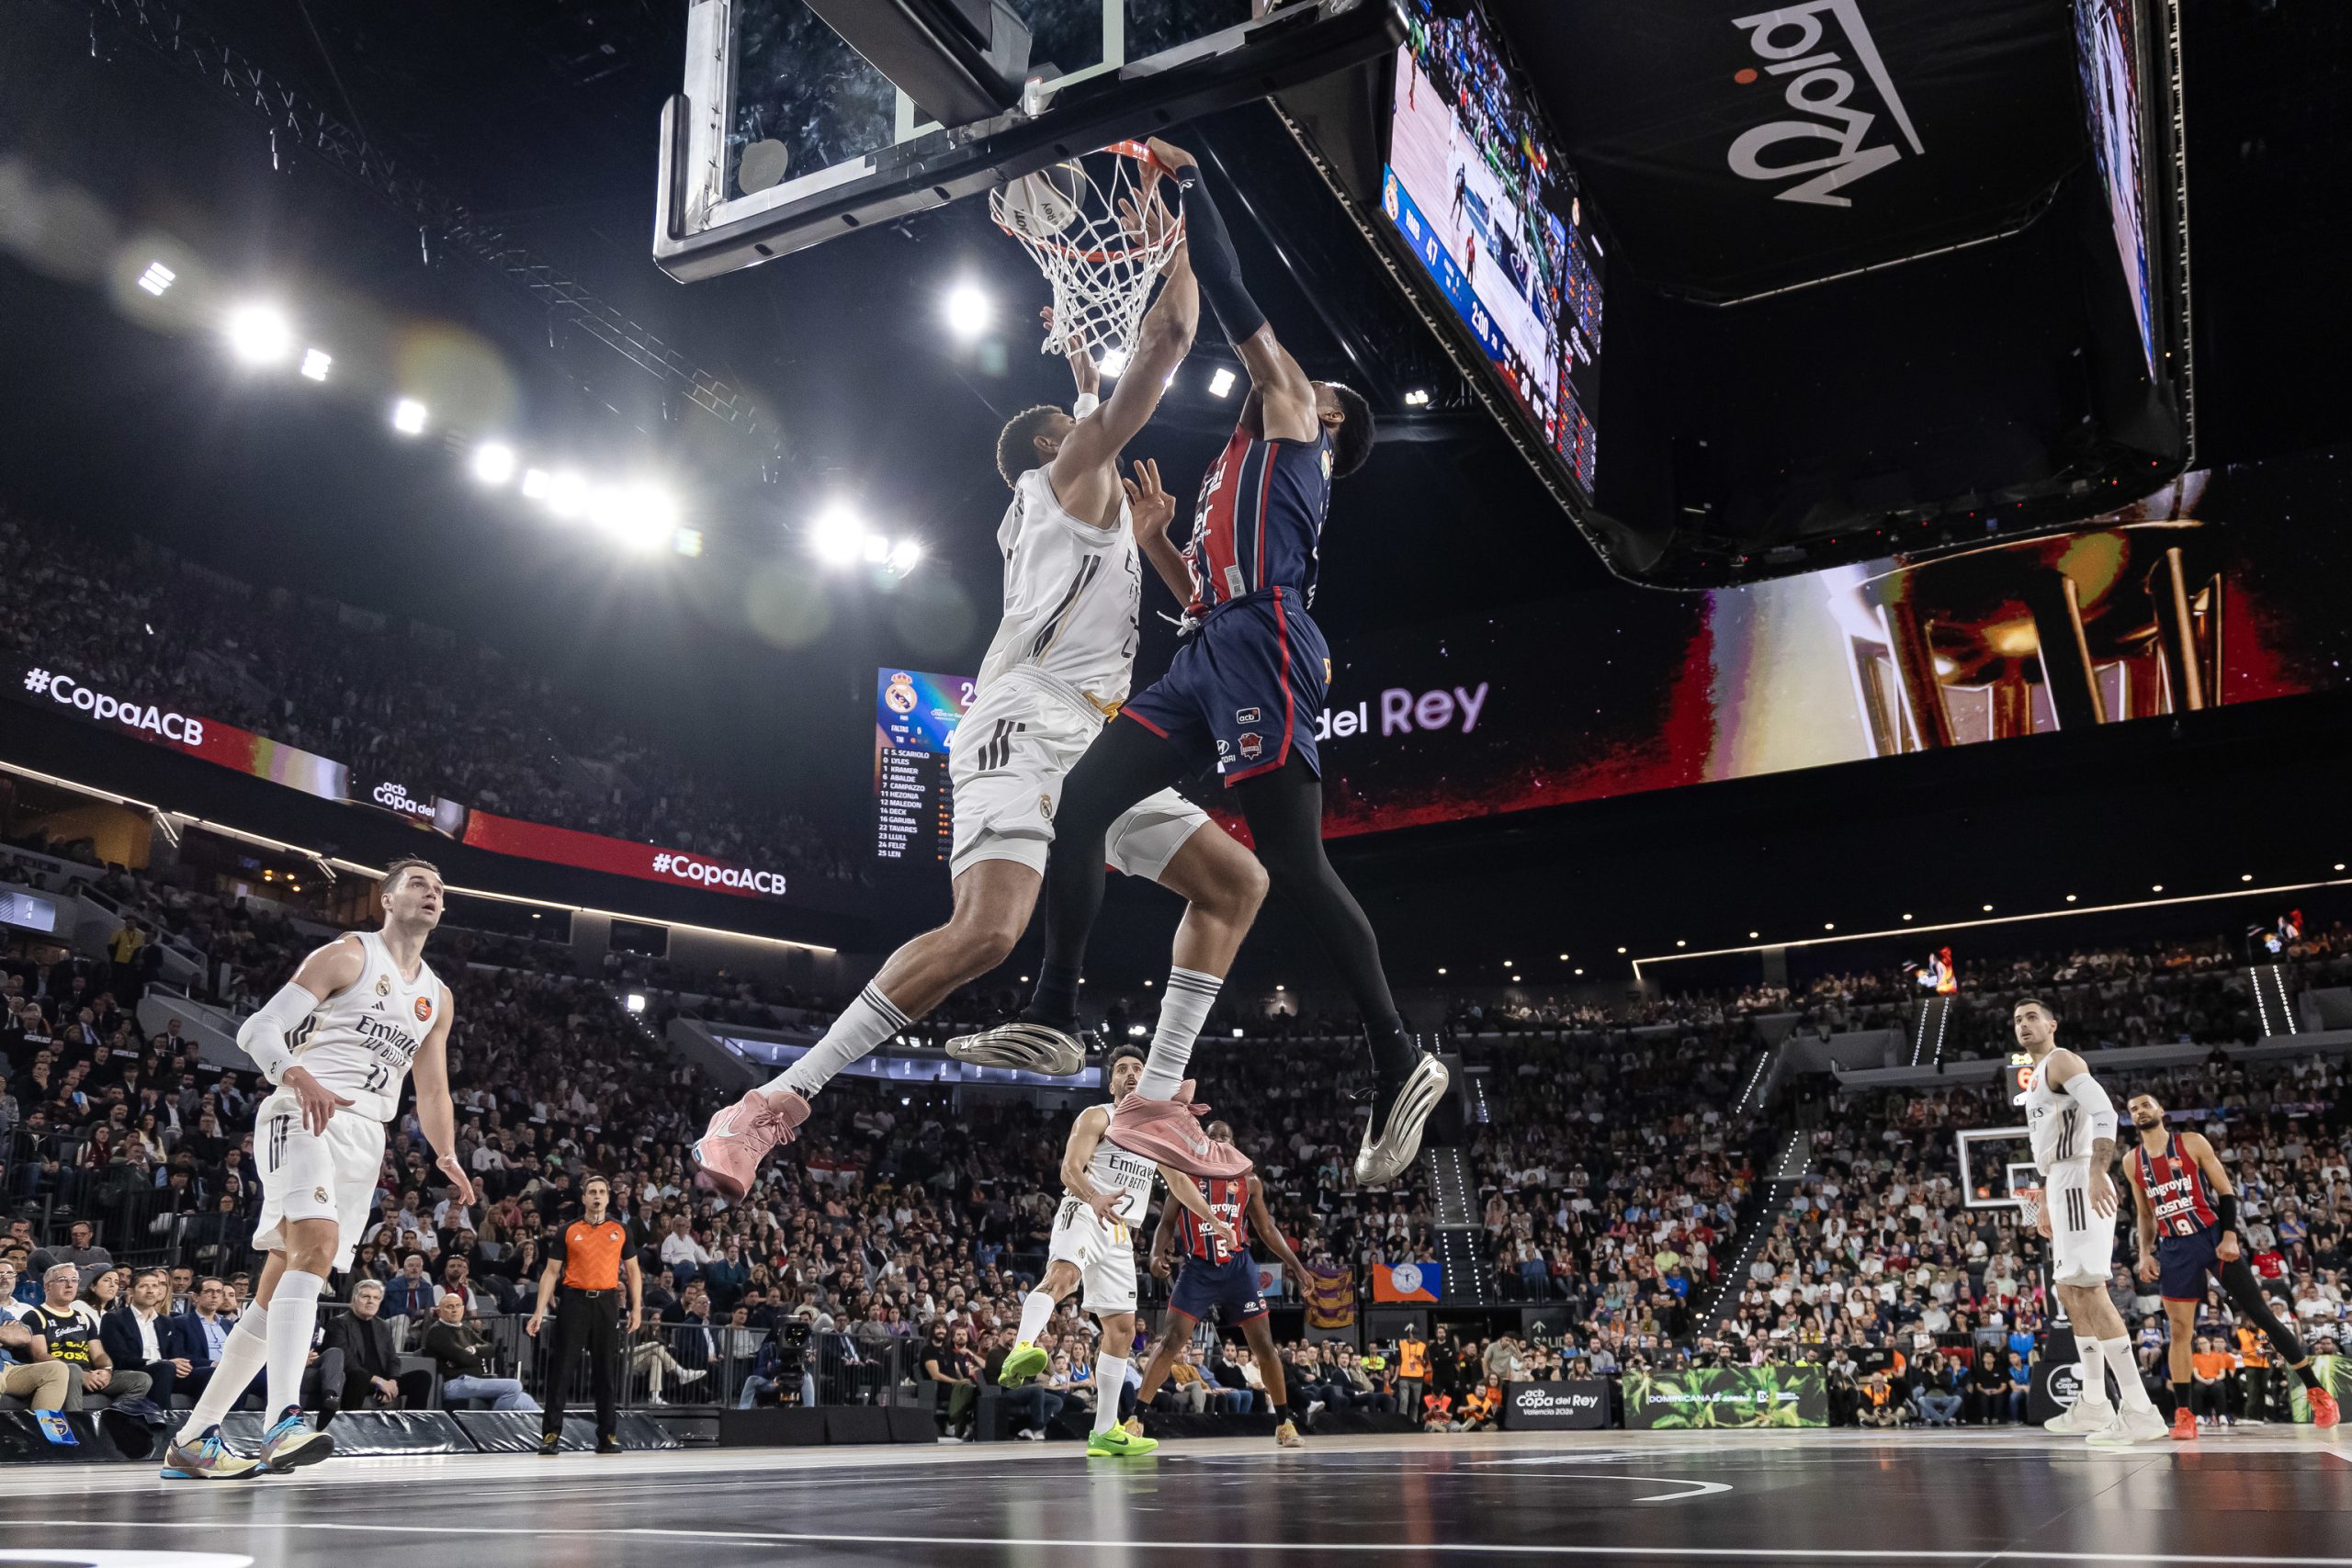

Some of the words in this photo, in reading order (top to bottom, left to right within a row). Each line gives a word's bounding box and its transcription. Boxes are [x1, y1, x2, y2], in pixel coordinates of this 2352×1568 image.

[24, 668, 203, 746] #CopaACB
[1381, 682, 1489, 737] Rey
[1238, 714, 1255, 722] acb
[890, 725, 910, 733] FALTAS
[899, 750, 930, 759] SCARIOLO
[890, 766, 919, 774] KRAMER
[890, 774, 916, 783] ABALDE
[383, 782, 407, 796] acb
[889, 783, 925, 792] CAMPAZZO
[373, 786, 417, 814] Copa
[417, 805, 435, 818] del
[889, 799, 922, 808] MALEDON
[888, 817, 916, 825] GARUBA
[888, 825, 918, 833] TAVARES
[888, 833, 908, 841] LLULL
[652, 853, 786, 895] #CopaACB
[1109, 1154, 1154, 1180] Emirate
[1114, 1172, 1129, 1189] FLY
[1211, 1202, 1241, 1215] groyal
[2176, 1218, 2194, 1236] 9
[1216, 1239, 1228, 1258] 5
[1525, 1389, 1545, 1398] acb
[1648, 1393, 1711, 1404] DOMINICANA
[1516, 1394, 1554, 1408] Copa
[1555, 1397, 1571, 1405] del
[1572, 1394, 1599, 1409] Rey
